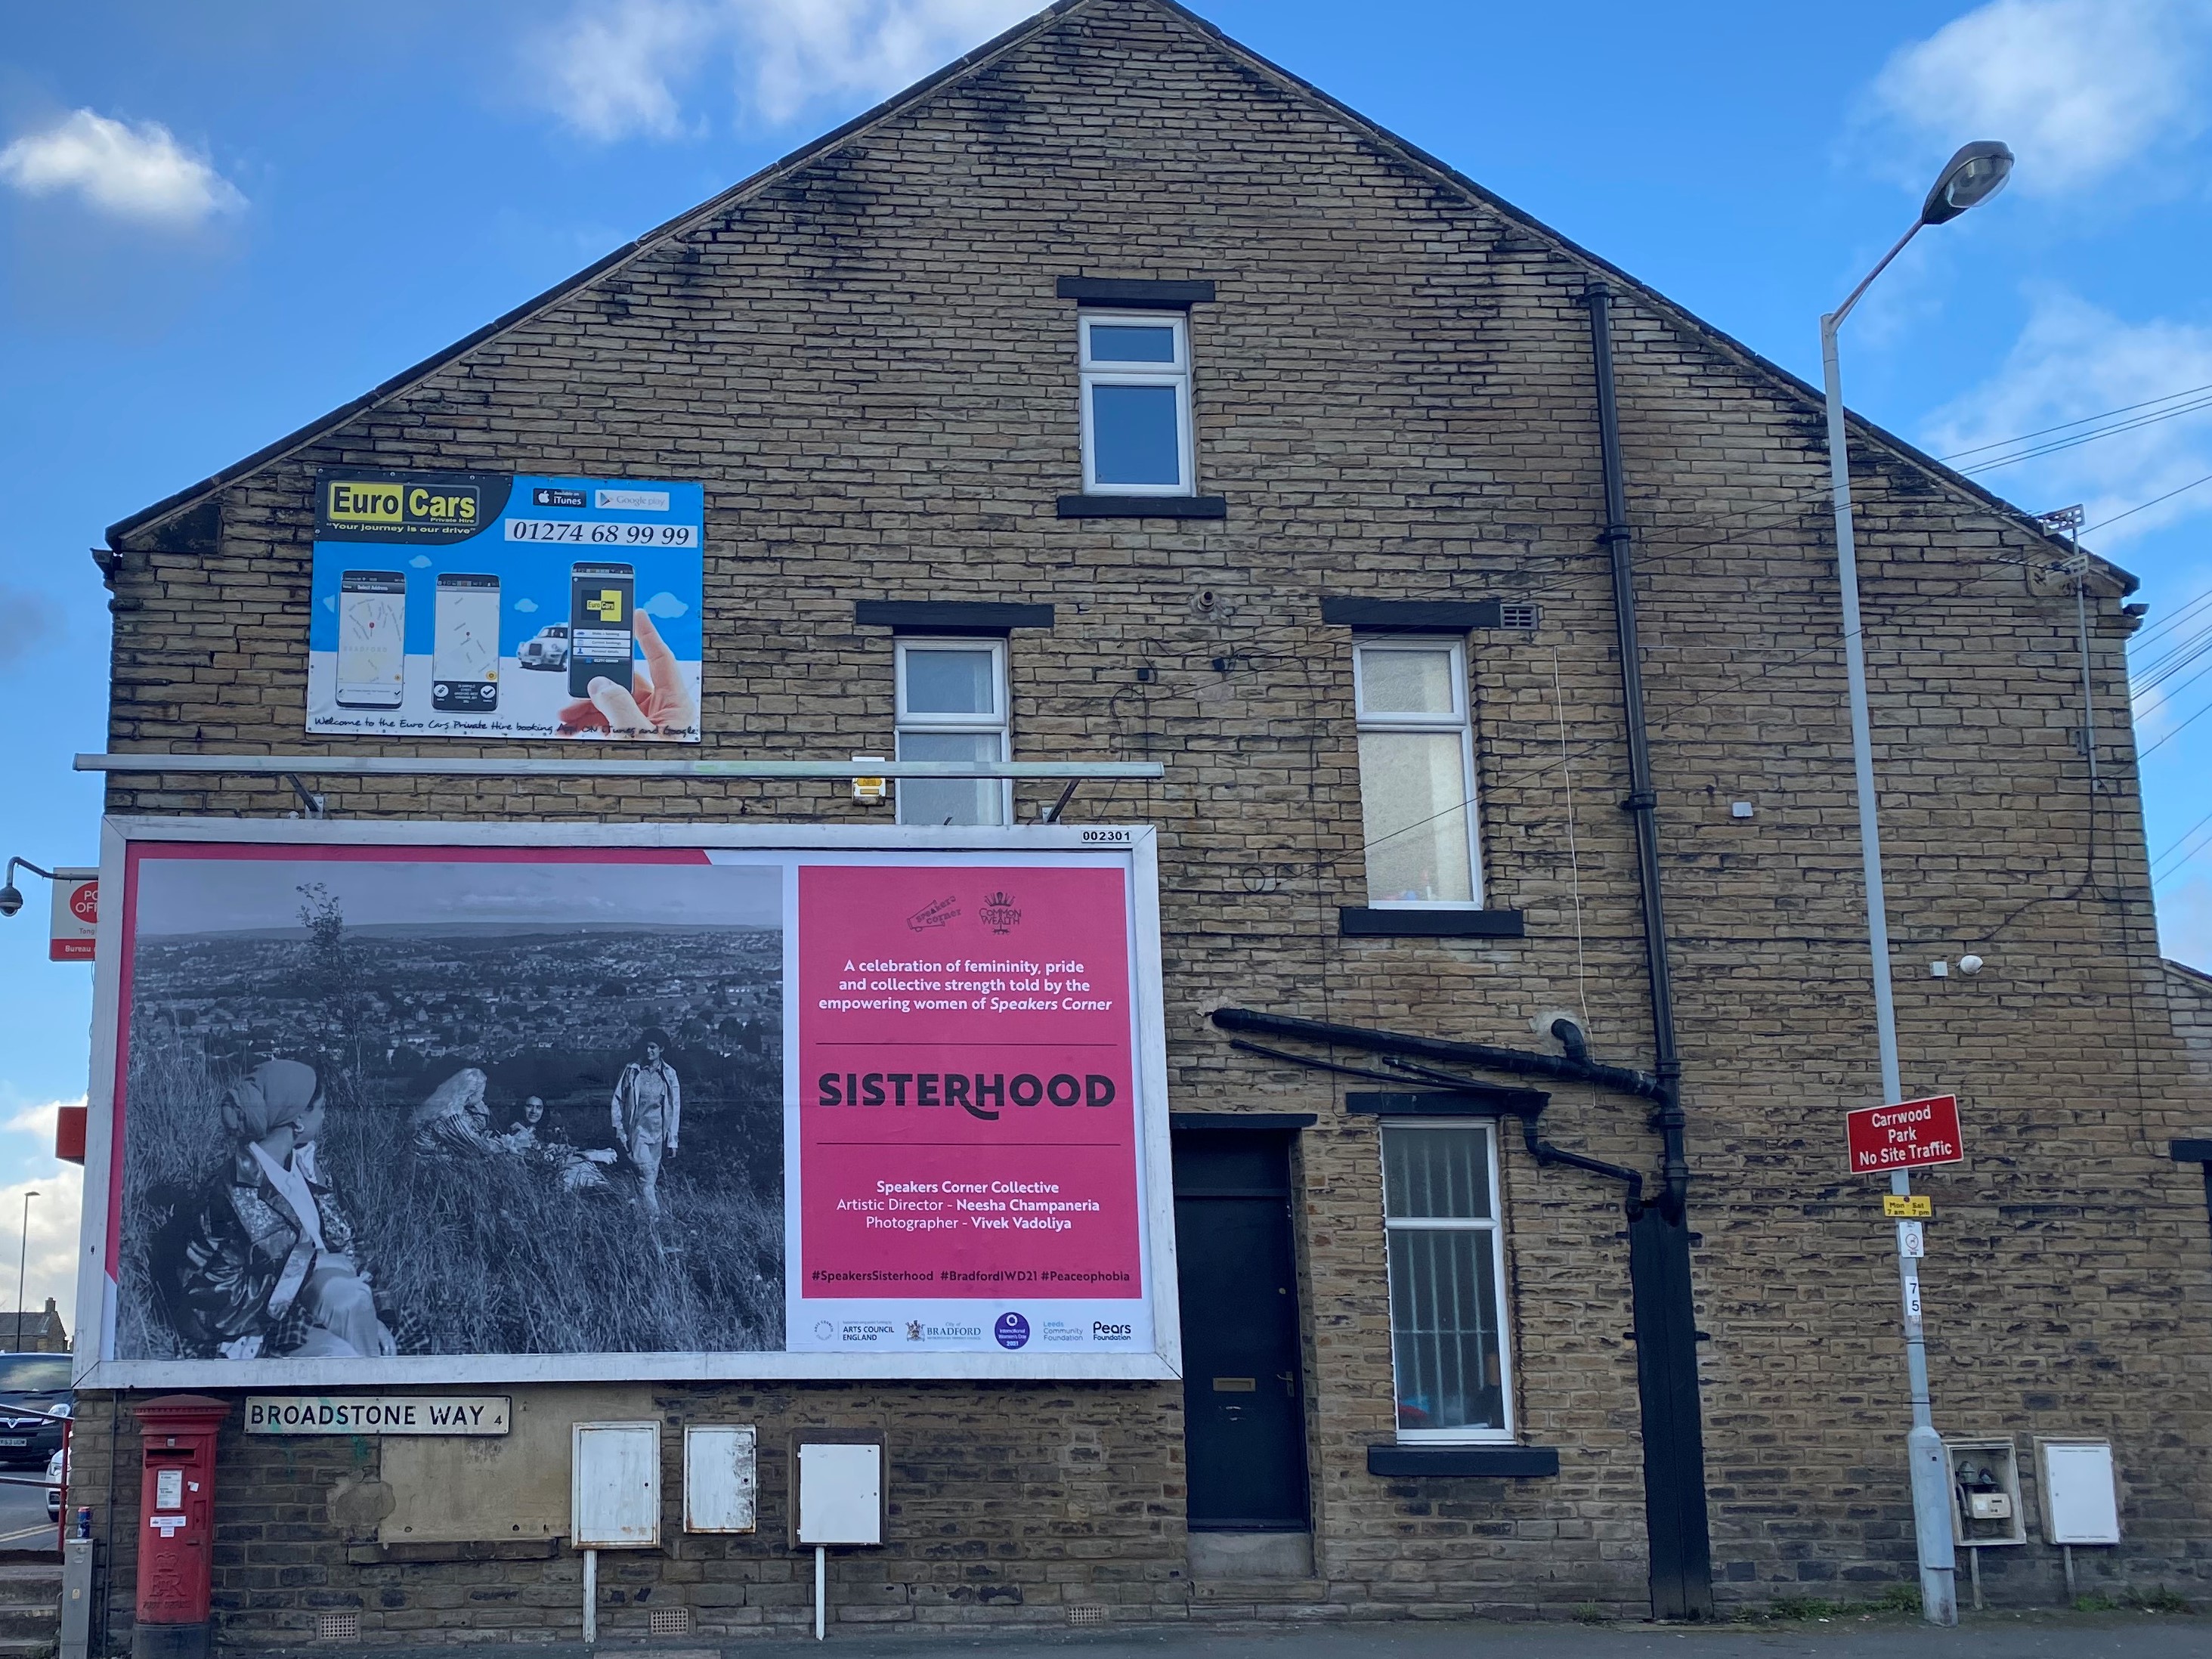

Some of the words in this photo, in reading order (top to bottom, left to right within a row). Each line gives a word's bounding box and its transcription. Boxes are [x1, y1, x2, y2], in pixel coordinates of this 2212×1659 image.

[333, 486, 398, 514] Euro
[409, 488, 475, 518] Cars
[553, 496, 582, 505] iTunes
[616, 495, 646, 508] Google
[648, 497, 665, 508] play
[360, 524, 404, 533] journey
[513, 522, 583, 541] 01274
[591, 525, 618, 543] 68
[626, 525, 654, 544] 99
[661, 528, 689, 546] 99
[315, 717, 361, 726] Welcome
[364, 718, 374, 727] to
[379, 718, 395, 727] the
[399, 719, 424, 729] Euro
[428, 720, 450, 730] Cars
[453, 720, 487, 729] Private
[491, 720, 512, 730] Hire
[516, 723, 553, 735] booking
[639, 726, 658, 735] and
[1082, 831, 1131, 841] 002301
[979, 908, 1022, 918] COMMON
[982, 916, 1019, 925] WEALTH
[844, 961, 855, 972] A
[859, 960, 942, 972] celebration
[946, 960, 961, 972] of
[964, 960, 1041, 975] femininity,
[1046, 961, 1084, 977] pride
[839, 979, 867, 991] and
[871, 979, 941, 992] collective
[945, 980, 1005, 995] strength
[1010, 980, 1040, 992] told
[1044, 980, 1063, 995] by
[1066, 980, 1090, 992] the
[819, 998, 910, 1013] empowering
[914, 1000, 967, 1010] women
[972, 998, 987, 1010] of
[990, 998, 1058, 1013] Speakers
[1063, 999, 1112, 1011] Corner
[818, 1073, 1115, 1120] SISTERHOOD
[1872, 1104, 1932, 1128] Carrwood
[1888, 1126, 1917, 1144] Park
[1860, 1150, 1877, 1167] No
[1881, 1147, 1906, 1164] Site
[1908, 1141, 1953, 1160] Traffic
[877, 1181, 939, 1196] Speakers
[942, 1181, 987, 1194] Corner
[992, 1181, 1060, 1194] Collective
[836, 1199, 884, 1212] Artistic
[889, 1199, 943, 1212] Director
[957, 1199, 1007, 1212] Neesha
[1010, 1199, 1100, 1215] Champaneria
[866, 1217, 958, 1232] Photographer
[971, 1217, 1008, 1230] Vivek
[1013, 1217, 1072, 1232] Vadoliya
[812, 1271, 934, 1285] #SpeakersSisterhood
[940, 1271, 1038, 1282] #BradfordIWD21
[1041, 1271, 1130, 1284] #Peaceophobia
[927, 1327, 981, 1336] BRADFORD
[1093, 1321, 1131, 1334] Pears
[251, 1406, 416, 1425] BROADSTONE
[429, 1406, 484, 1425] WAY
[494, 1415, 502, 1425] 4
